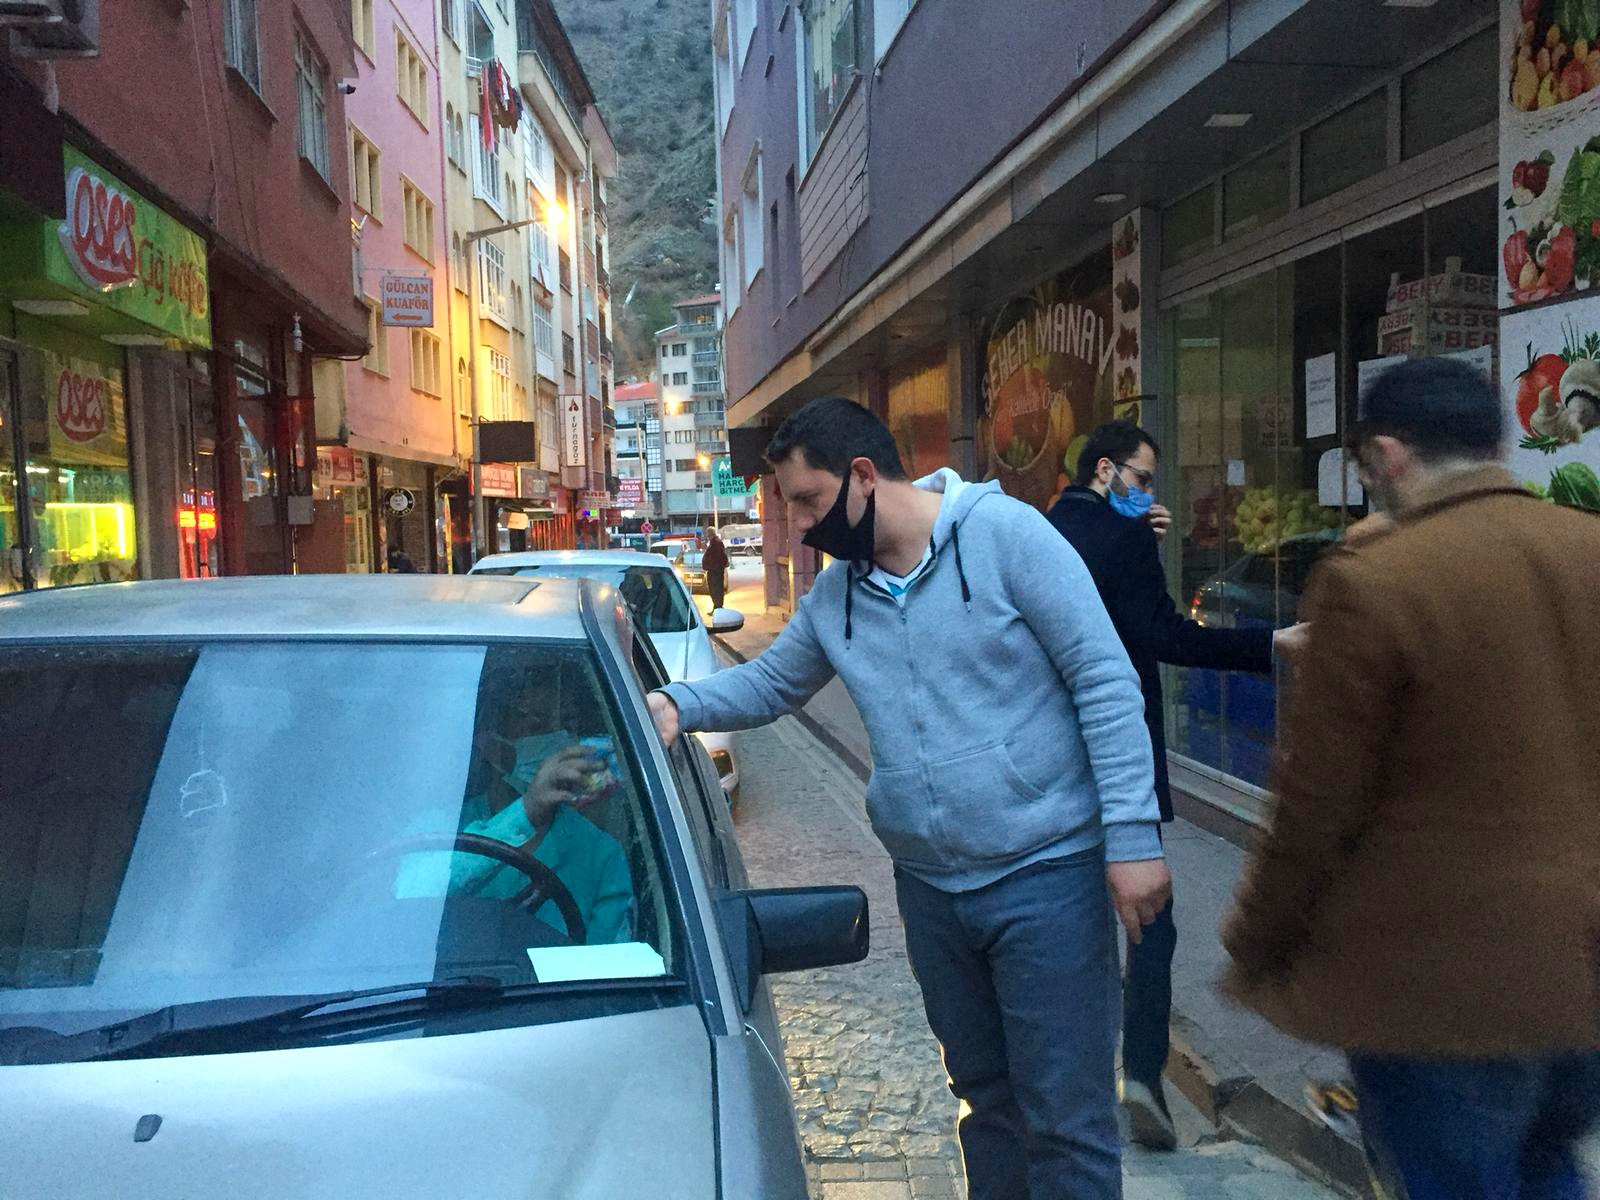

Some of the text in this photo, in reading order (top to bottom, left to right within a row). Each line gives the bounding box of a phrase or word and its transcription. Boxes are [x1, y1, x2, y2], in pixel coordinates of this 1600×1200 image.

[386, 280, 429, 294] GÜLCAN
[386, 296, 429, 310] KUAFÖR
[1035, 303, 1119, 376] MANAV
[719, 479, 744, 487] HARC
